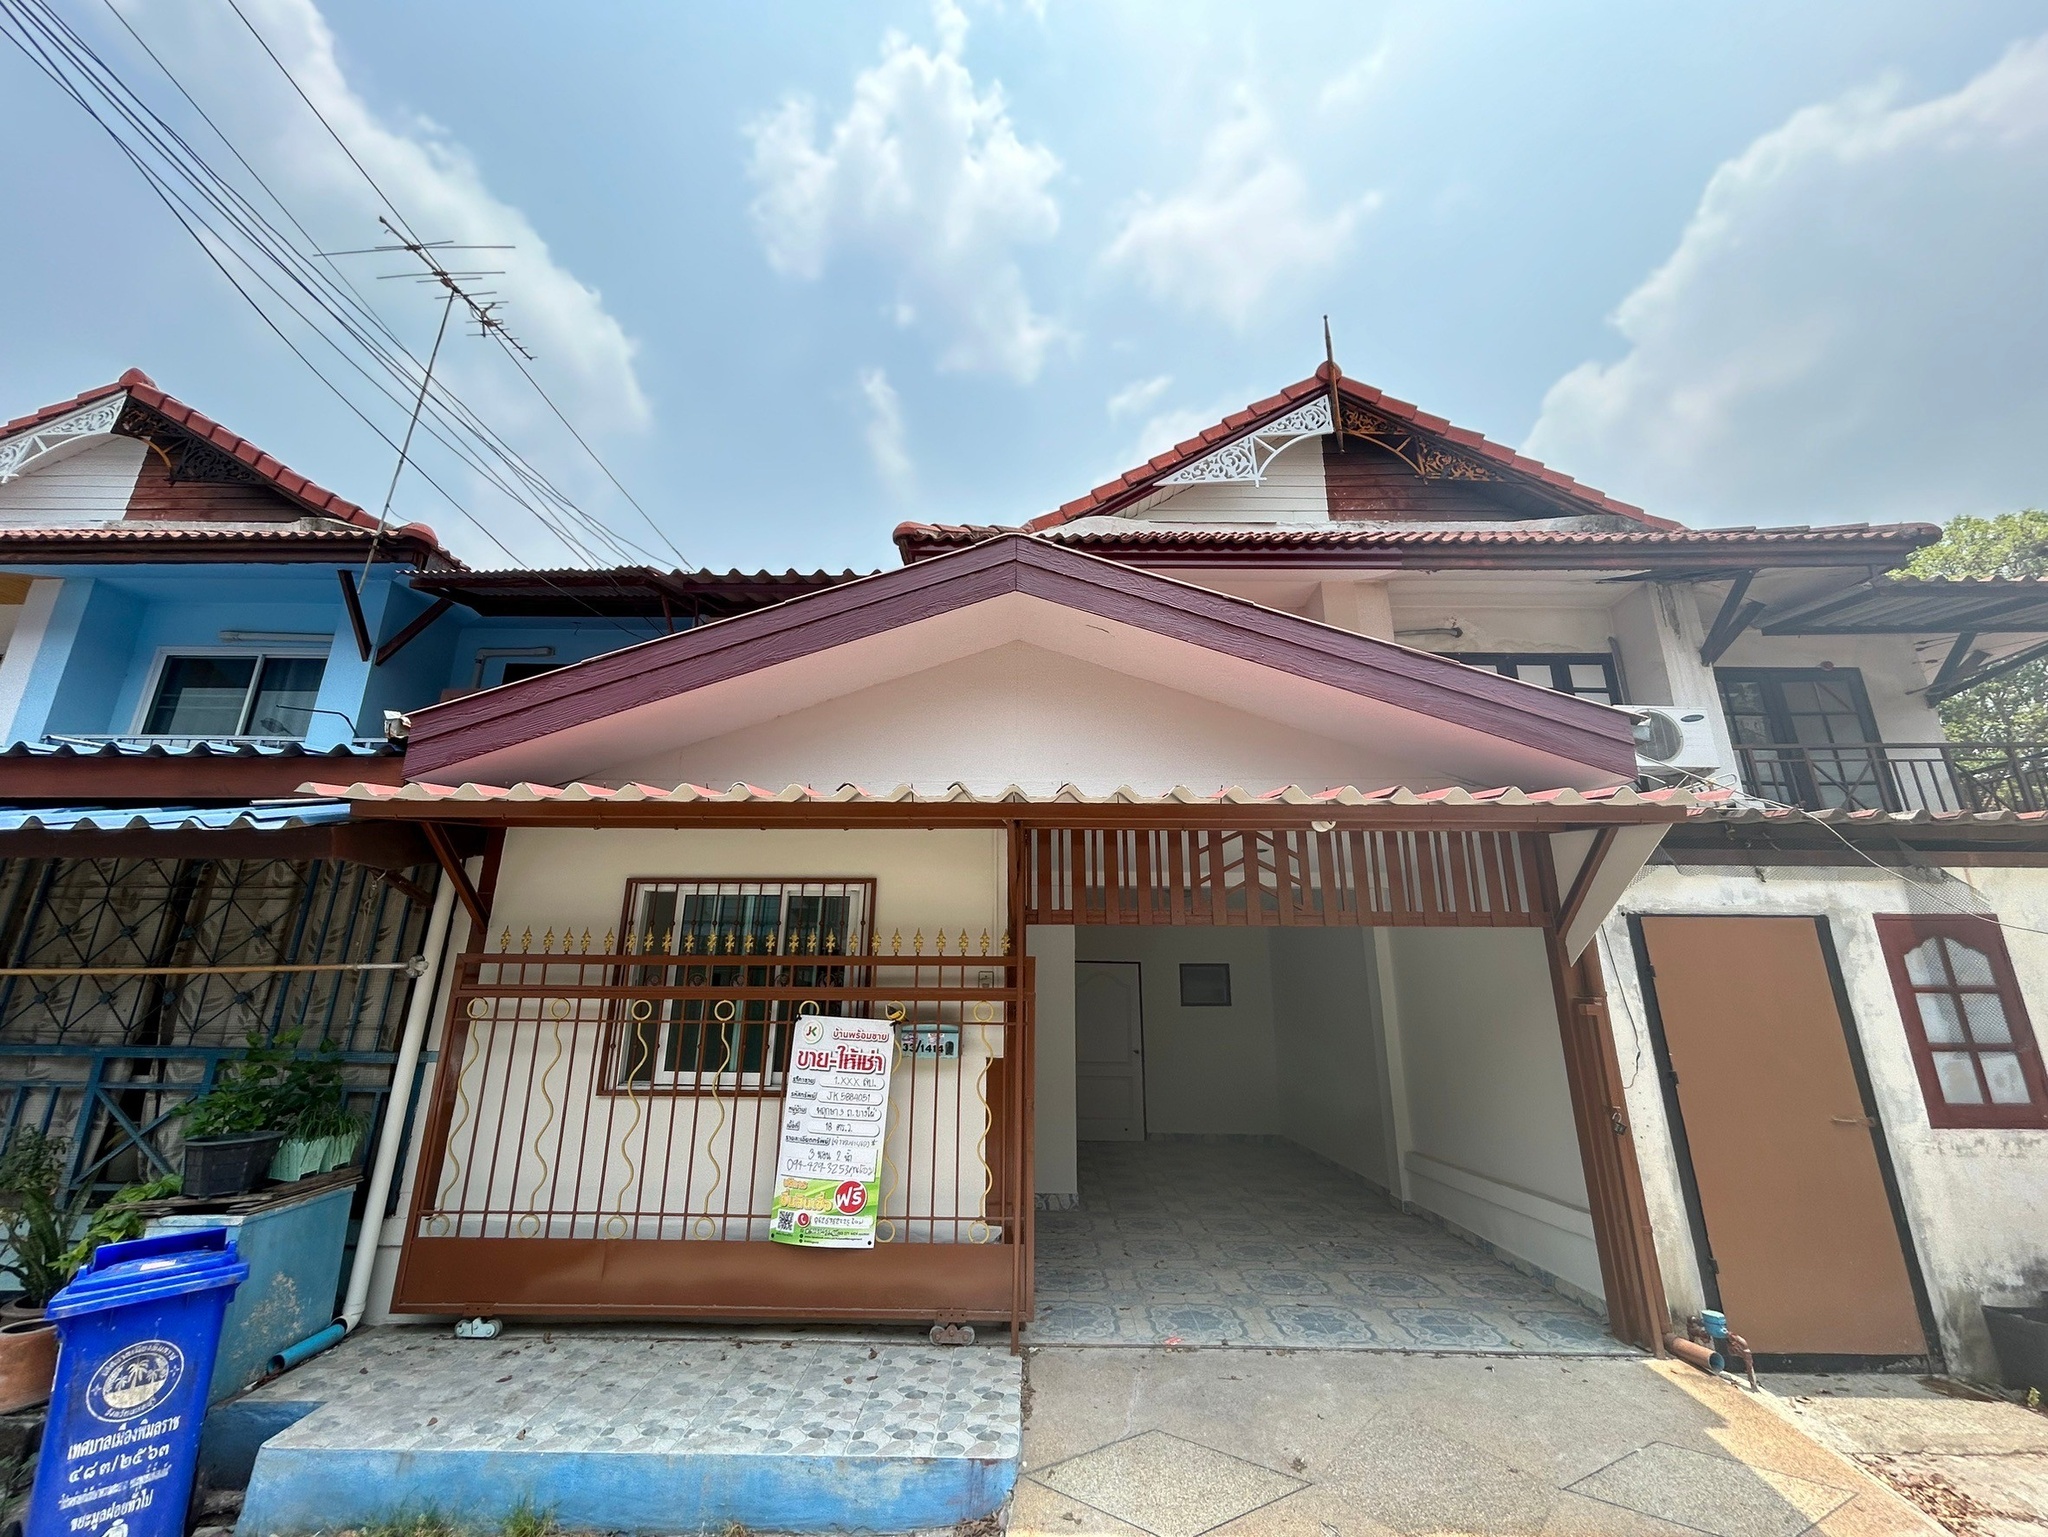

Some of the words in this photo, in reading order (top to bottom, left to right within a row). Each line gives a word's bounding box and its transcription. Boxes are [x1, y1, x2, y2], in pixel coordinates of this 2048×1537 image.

[833, 1027, 889, 1041] บ้านพร้อมขาย
[798, 1045, 883, 1072] ขาย-ให้เช่า
[836, 1186, 864, 1208] ฟรี
[67, 1415, 181, 1462] เทศบาลเมืองพิมลราช
[70, 1487, 154, 1532] ขยะมูลฝอยทั่วไป
